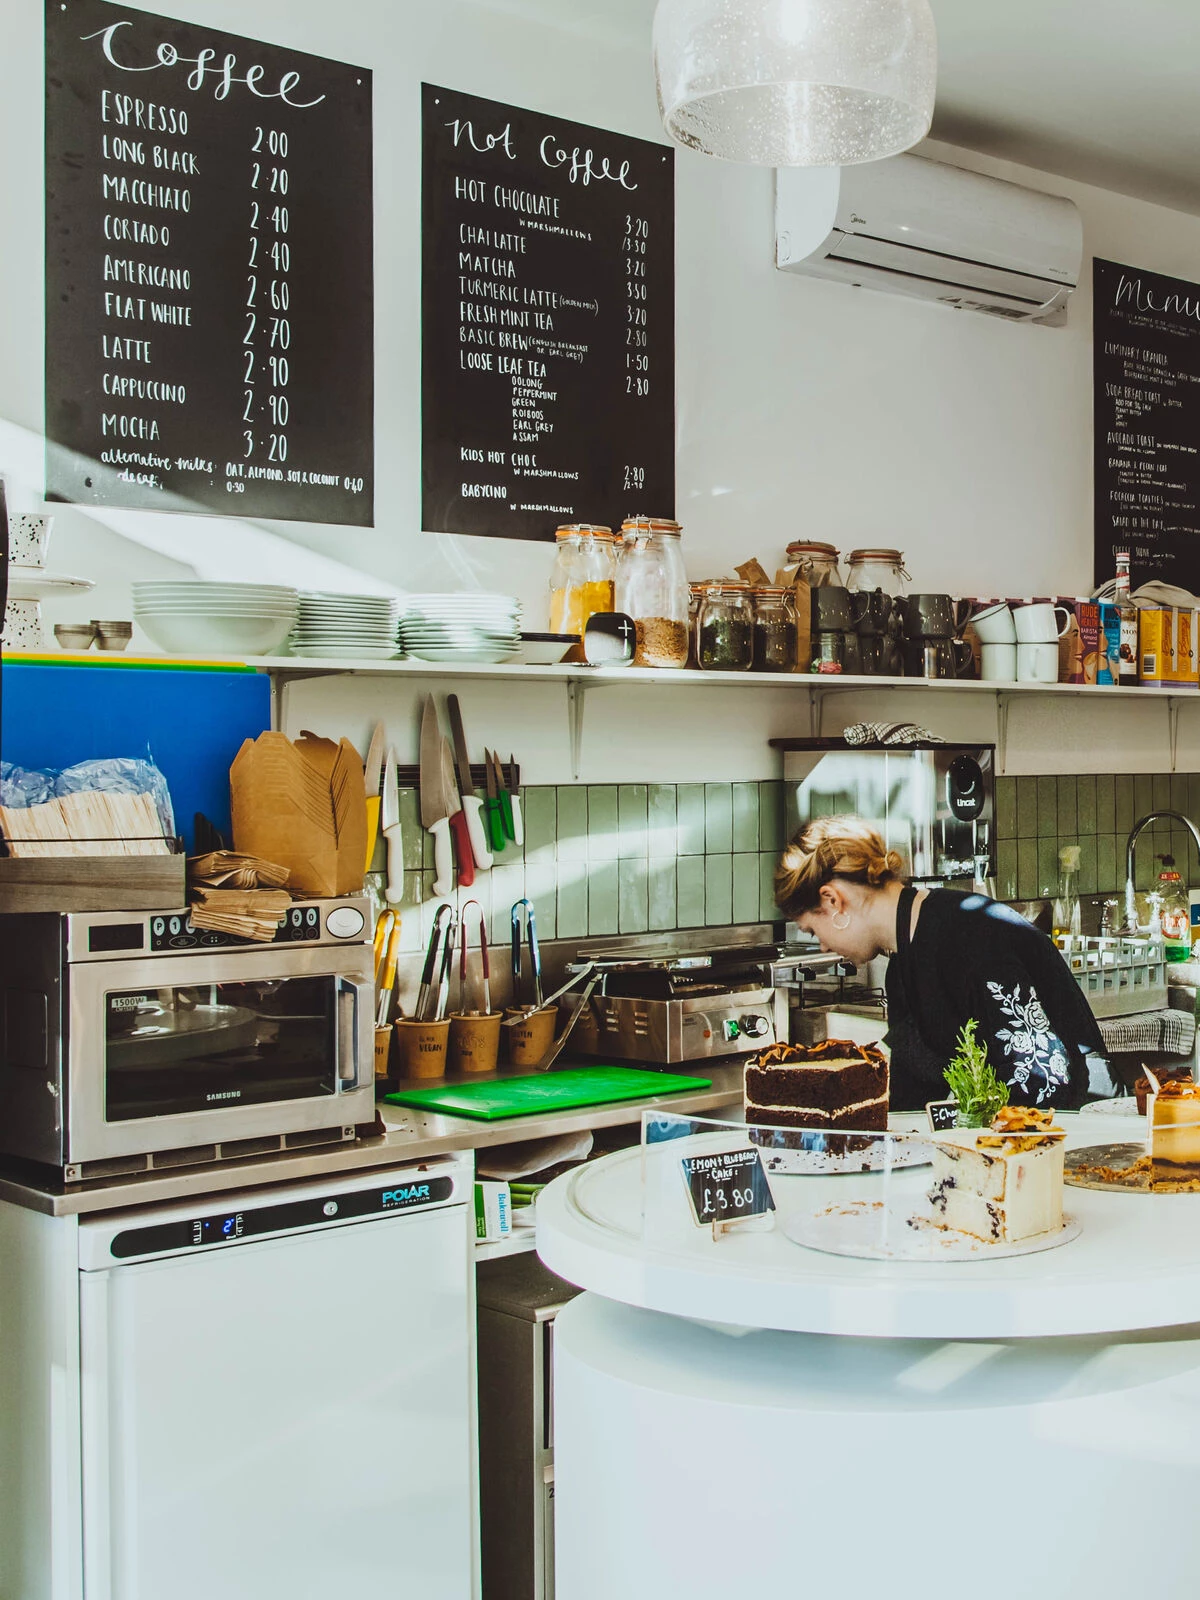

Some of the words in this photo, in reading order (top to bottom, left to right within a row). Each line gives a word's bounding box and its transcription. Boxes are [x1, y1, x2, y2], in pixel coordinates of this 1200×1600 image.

[80, 21, 325, 107] Coffee
[102, 90, 188, 135] ESPRESSO
[103, 134, 145, 165] LONG
[153, 145, 200, 175] BLACK
[444, 119, 517, 160] Not
[540, 134, 638, 191] Coffee
[103, 174, 191, 212] MACCHIATO
[455, 176, 486, 203] HOT
[494, 185, 560, 219] CHOCOLATE
[104, 214, 169, 246] CORTADO
[460, 223, 490, 246] CHAI
[494, 230, 527, 254] LATTE
[527, 220, 592, 242] MARSHMALLOWS
[104, 255, 191, 290] AMERICANO
[459, 252, 516, 278] MATCHA
[459, 276, 519, 303] TURMERIC
[524, 287, 558, 309] LATTE
[105, 292, 146, 321] FLAT
[151, 301, 191, 326] WHITE
[460, 301, 497, 324] FRESH
[500, 308, 529, 328] MINT
[533, 312, 554, 331] TEA
[103, 335, 151, 363] LATTE
[460, 326, 495, 347] BASIC
[498, 331, 529, 351] BREW
[460, 350, 493, 371] LOOSE
[498, 355, 523, 375] LEAF
[527, 360, 547, 377] TEA
[103, 374, 186, 404] CAPPUCCINO
[512, 376, 543, 389] OOLONG
[513, 387, 557, 401] PEPPERMINT
[512, 398, 536, 407] GREEN
[102, 413, 160, 440] MOCHA
[512, 432, 539, 442] ASSAM
[513, 419, 532, 431] EARL
[535, 422, 554, 433] GREY
[1107, 431, 1134, 445] AVOCADO
[1137, 434, 1155, 448] TOAST
[101, 448, 171, 471] alternative
[309, 472, 339, 486] COCONUT
[461, 447, 483, 463] KIDS
[488, 451, 505, 465] HOT
[511, 453, 537, 466] CHOC
[524, 469, 579, 480] MARSHMALLOWS
[461, 483, 507, 499] BABYCINO
[520, 504, 573, 514] MARSHMALLOWS
[1081, 605, 1097, 618] RUDE
[206, 1090, 241, 1101] SAMSUNG
[382, 1184, 429, 1203] POLAR
[498, 1193, 509, 1232] Bakewell
